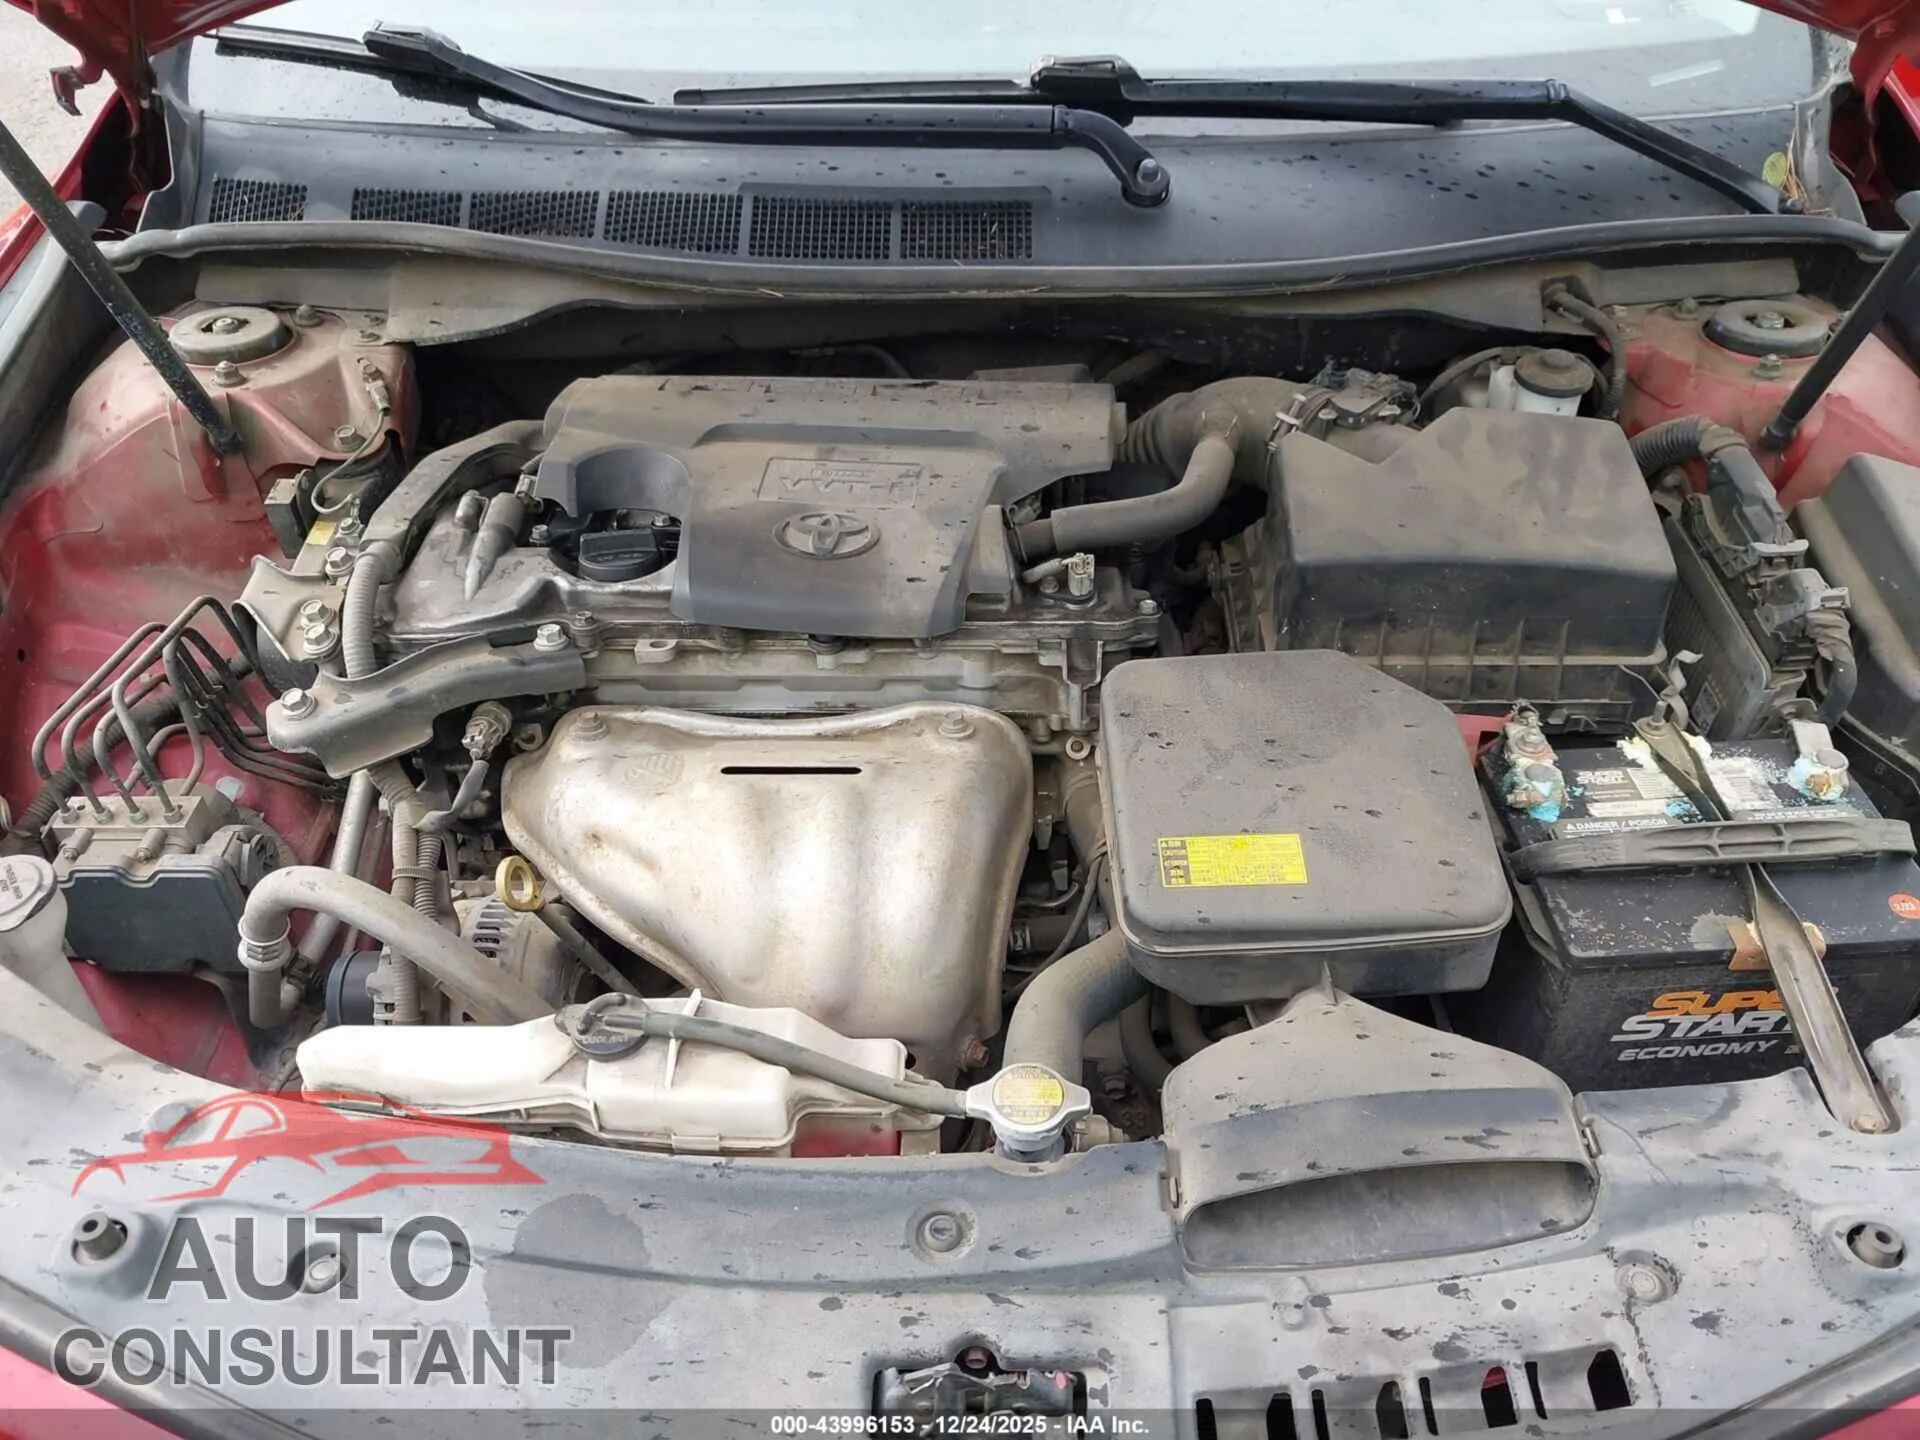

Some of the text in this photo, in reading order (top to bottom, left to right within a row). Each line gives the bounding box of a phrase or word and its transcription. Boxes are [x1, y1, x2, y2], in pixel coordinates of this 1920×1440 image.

[1576, 821, 1618, 831] DANGER
[1628, 818, 1668, 828] POISON
[1646, 990, 1784, 1017] SUPE
[1611, 1010, 1792, 1042] STAR
[1617, 1040, 1779, 1061] ECONOMY
